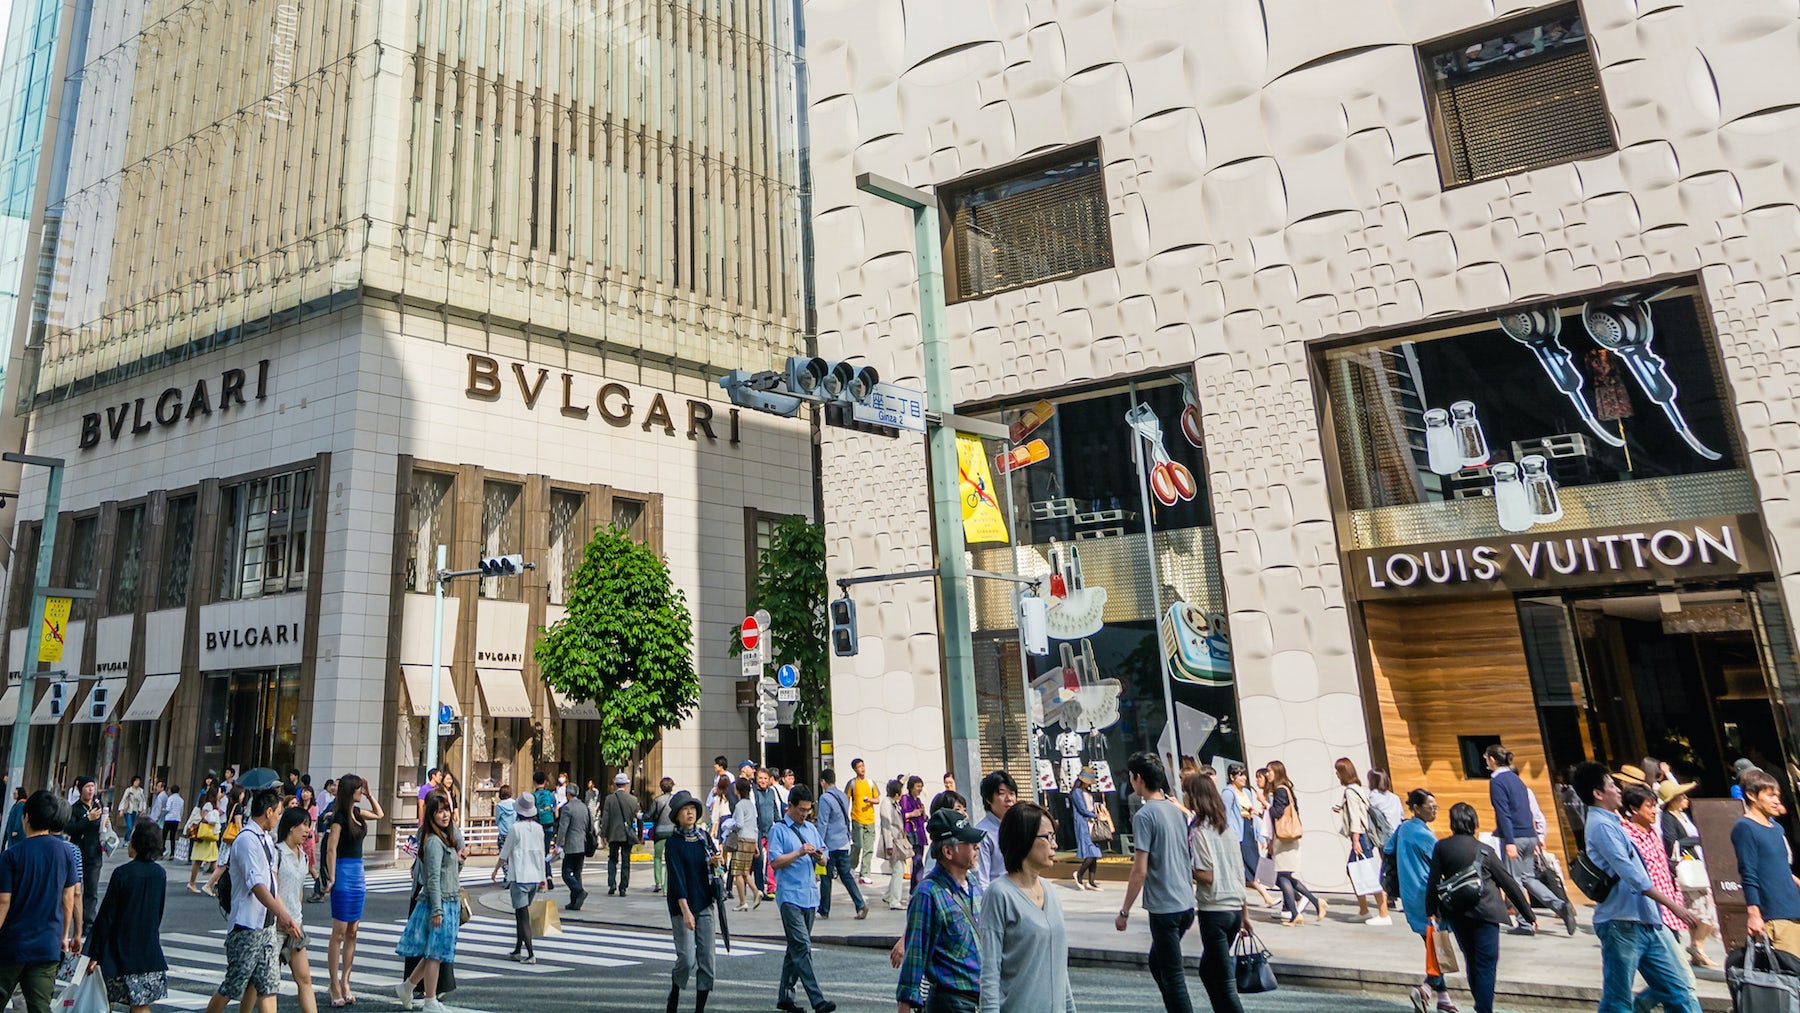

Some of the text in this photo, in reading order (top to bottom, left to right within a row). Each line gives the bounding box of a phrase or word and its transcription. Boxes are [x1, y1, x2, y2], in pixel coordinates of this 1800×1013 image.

[79, 359, 270, 449] BVLGARI
[465, 353, 741, 445] BVLGARI
[859, 393, 920, 417] 座二丁目
[879, 410, 904, 425] Ginza 2
[1367, 525, 1740, 588] LOUIS VUITTON
[206, 623, 298, 649] BVLGARI
[97, 661, 128, 672] BVLGAR
[478, 651, 522, 662] BVLGARI
[490, 706, 530, 714] BVLGARI
